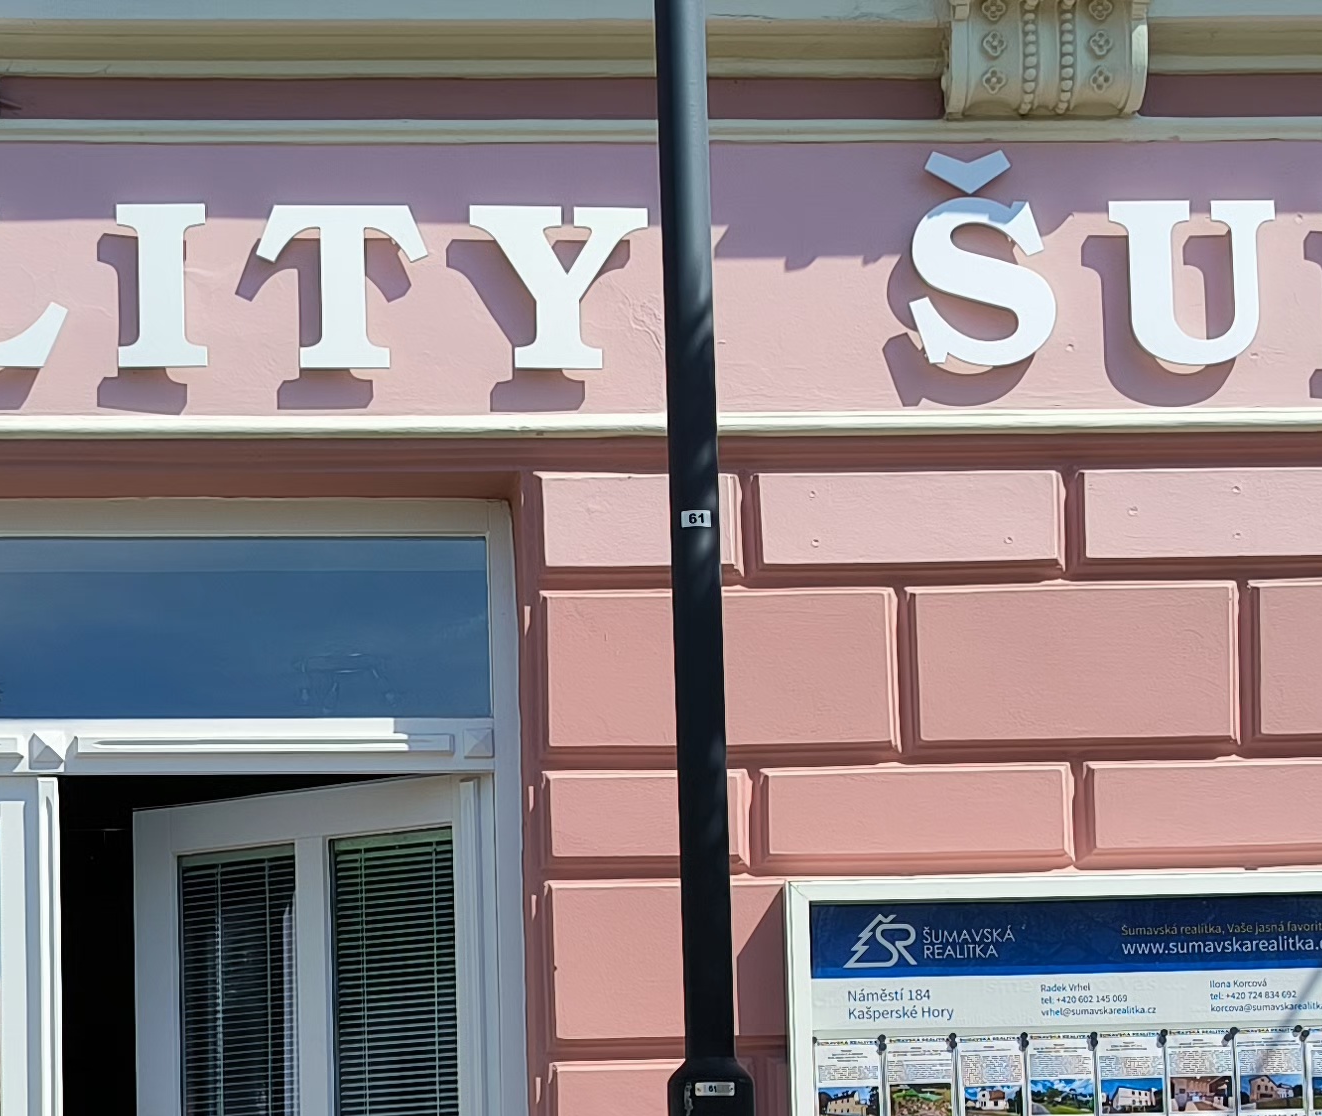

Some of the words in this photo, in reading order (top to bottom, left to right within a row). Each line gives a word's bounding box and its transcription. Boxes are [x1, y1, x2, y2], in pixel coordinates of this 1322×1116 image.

[688, 512, 705, 525] 61
[923, 925, 1016, 944] ŠUMAVSKÁ
[1121, 924, 1177, 936] Šumavská
[1180, 923, 1225, 936] realitka,
[1227, 923, 1253, 933] Vaše
[1255, 922, 1285, 935] jasná
[923, 944, 999, 959] REALITKA
[1041, 983, 1067, 992] Radek
[1068, 982, 1090, 992] Vrhel
[1209, 980, 1231, 989] Ilona
[1233, 978, 1267, 988] Korcová
[848, 987, 904, 1002] Náměstí
[907, 988, 931, 1001] 184
[1056, 995, 1077, 1003] +420
[1096, 994, 1111, 1003] 145
[1226, 991, 1246, 1000] +420
[1247, 991, 1263, 999] 724
[1264, 990, 1280, 999] 834
[848, 1006, 918, 1022] Kašperské
[921, 1006, 954, 1021] Hory
[1041, 1005, 1157, 1018] vrhel@sumavskarealitka.cz
